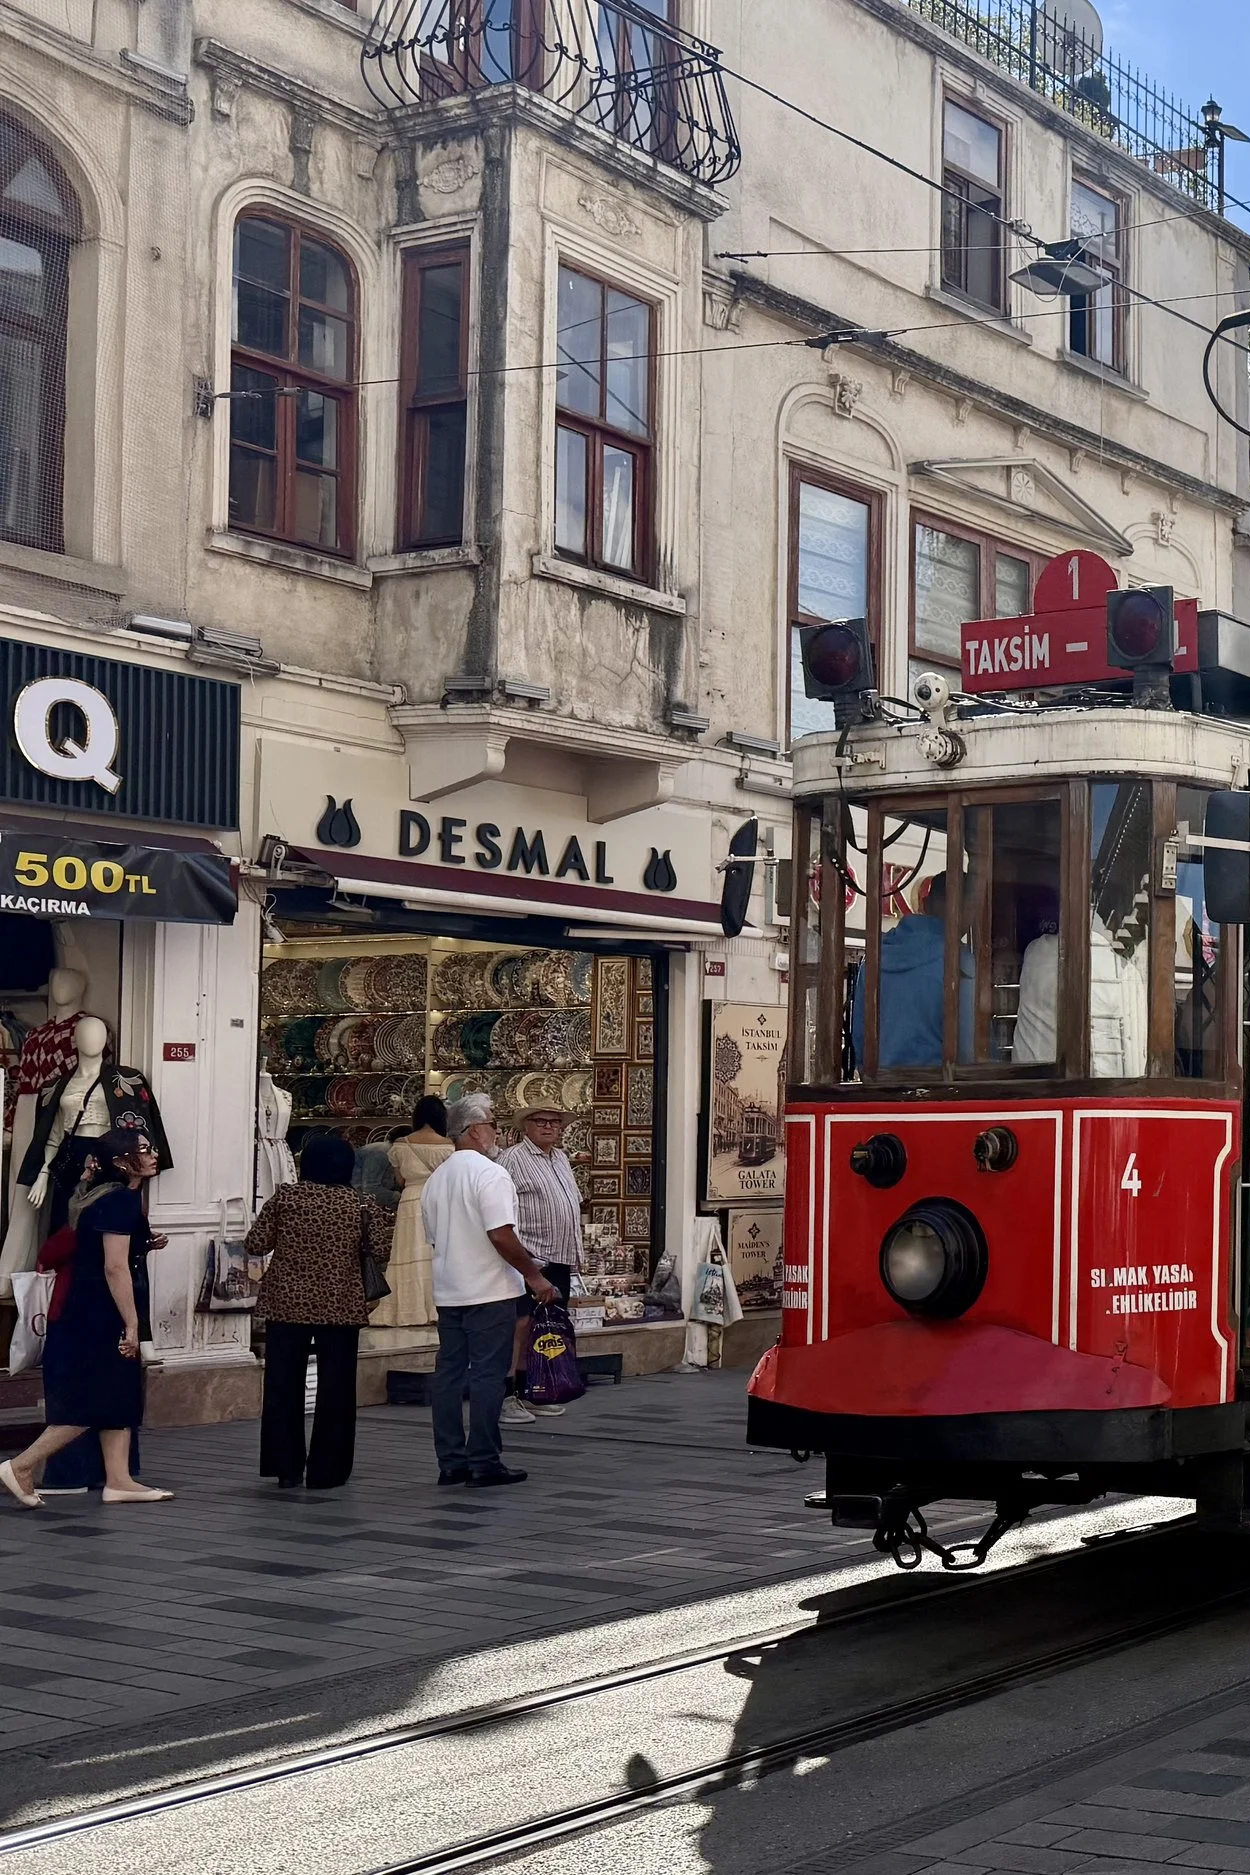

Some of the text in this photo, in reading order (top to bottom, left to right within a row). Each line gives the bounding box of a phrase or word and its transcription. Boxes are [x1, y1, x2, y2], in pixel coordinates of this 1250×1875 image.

[1067, 555, 1079, 600] 1
[965, 625, 1050, 676] TAKSİM
[14, 674, 123, 796] Q
[398, 809, 614, 884] DESMAL
[0, 894, 91, 916] KAÇIRMA
[741, 1027, 782, 1039] İSTANBUL
[170, 1047, 189, 1058] 255
[745, 1040, 778, 1051] TAKSİM
[738, 1169, 777, 1180] GALATA
[739, 1179, 776, 1190] TOWER
[1120, 1152, 1142, 1197] 4
[741, 1251, 767, 1259] TOWER
[1105, 1287, 1197, 1315] EHLİKELİDİR
